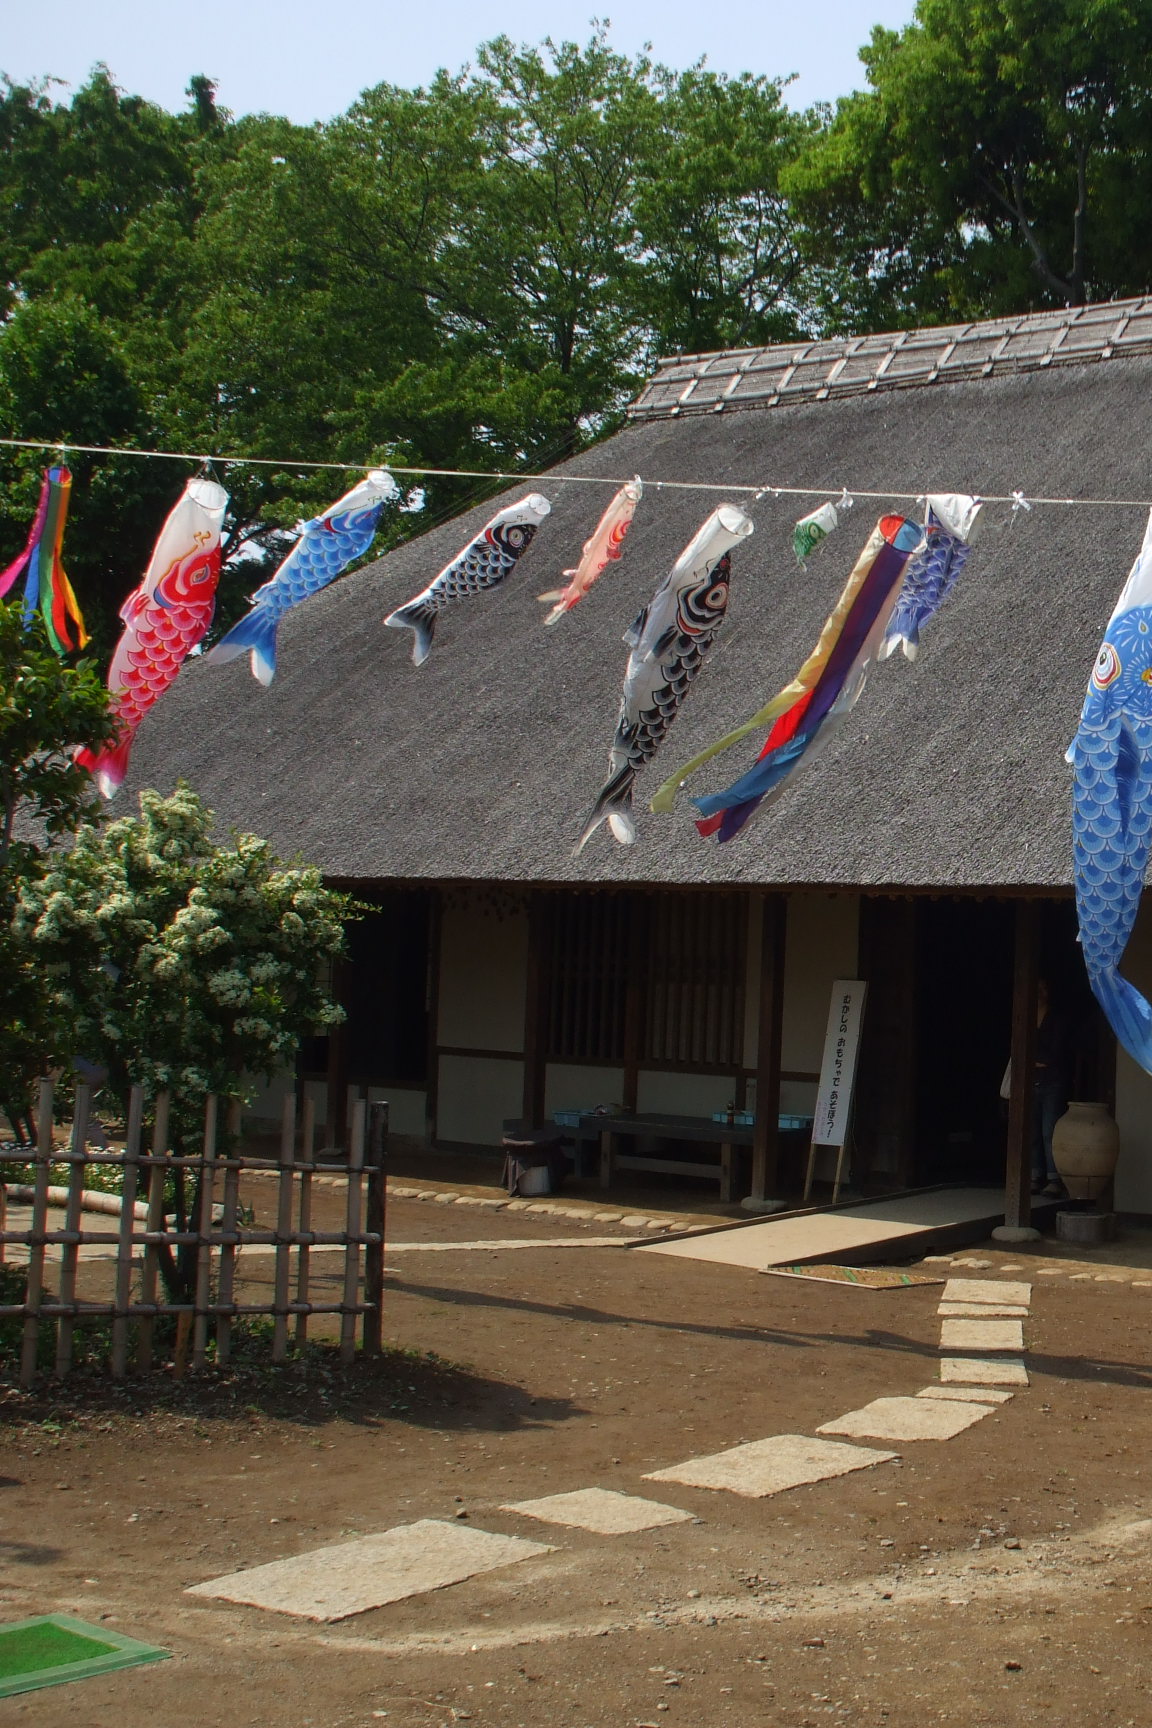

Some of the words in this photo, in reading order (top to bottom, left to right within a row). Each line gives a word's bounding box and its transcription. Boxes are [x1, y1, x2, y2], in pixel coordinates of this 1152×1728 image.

[840, 994, 851, 1033] むかしの
[832, 1037, 846, 1087] おもちゃで
